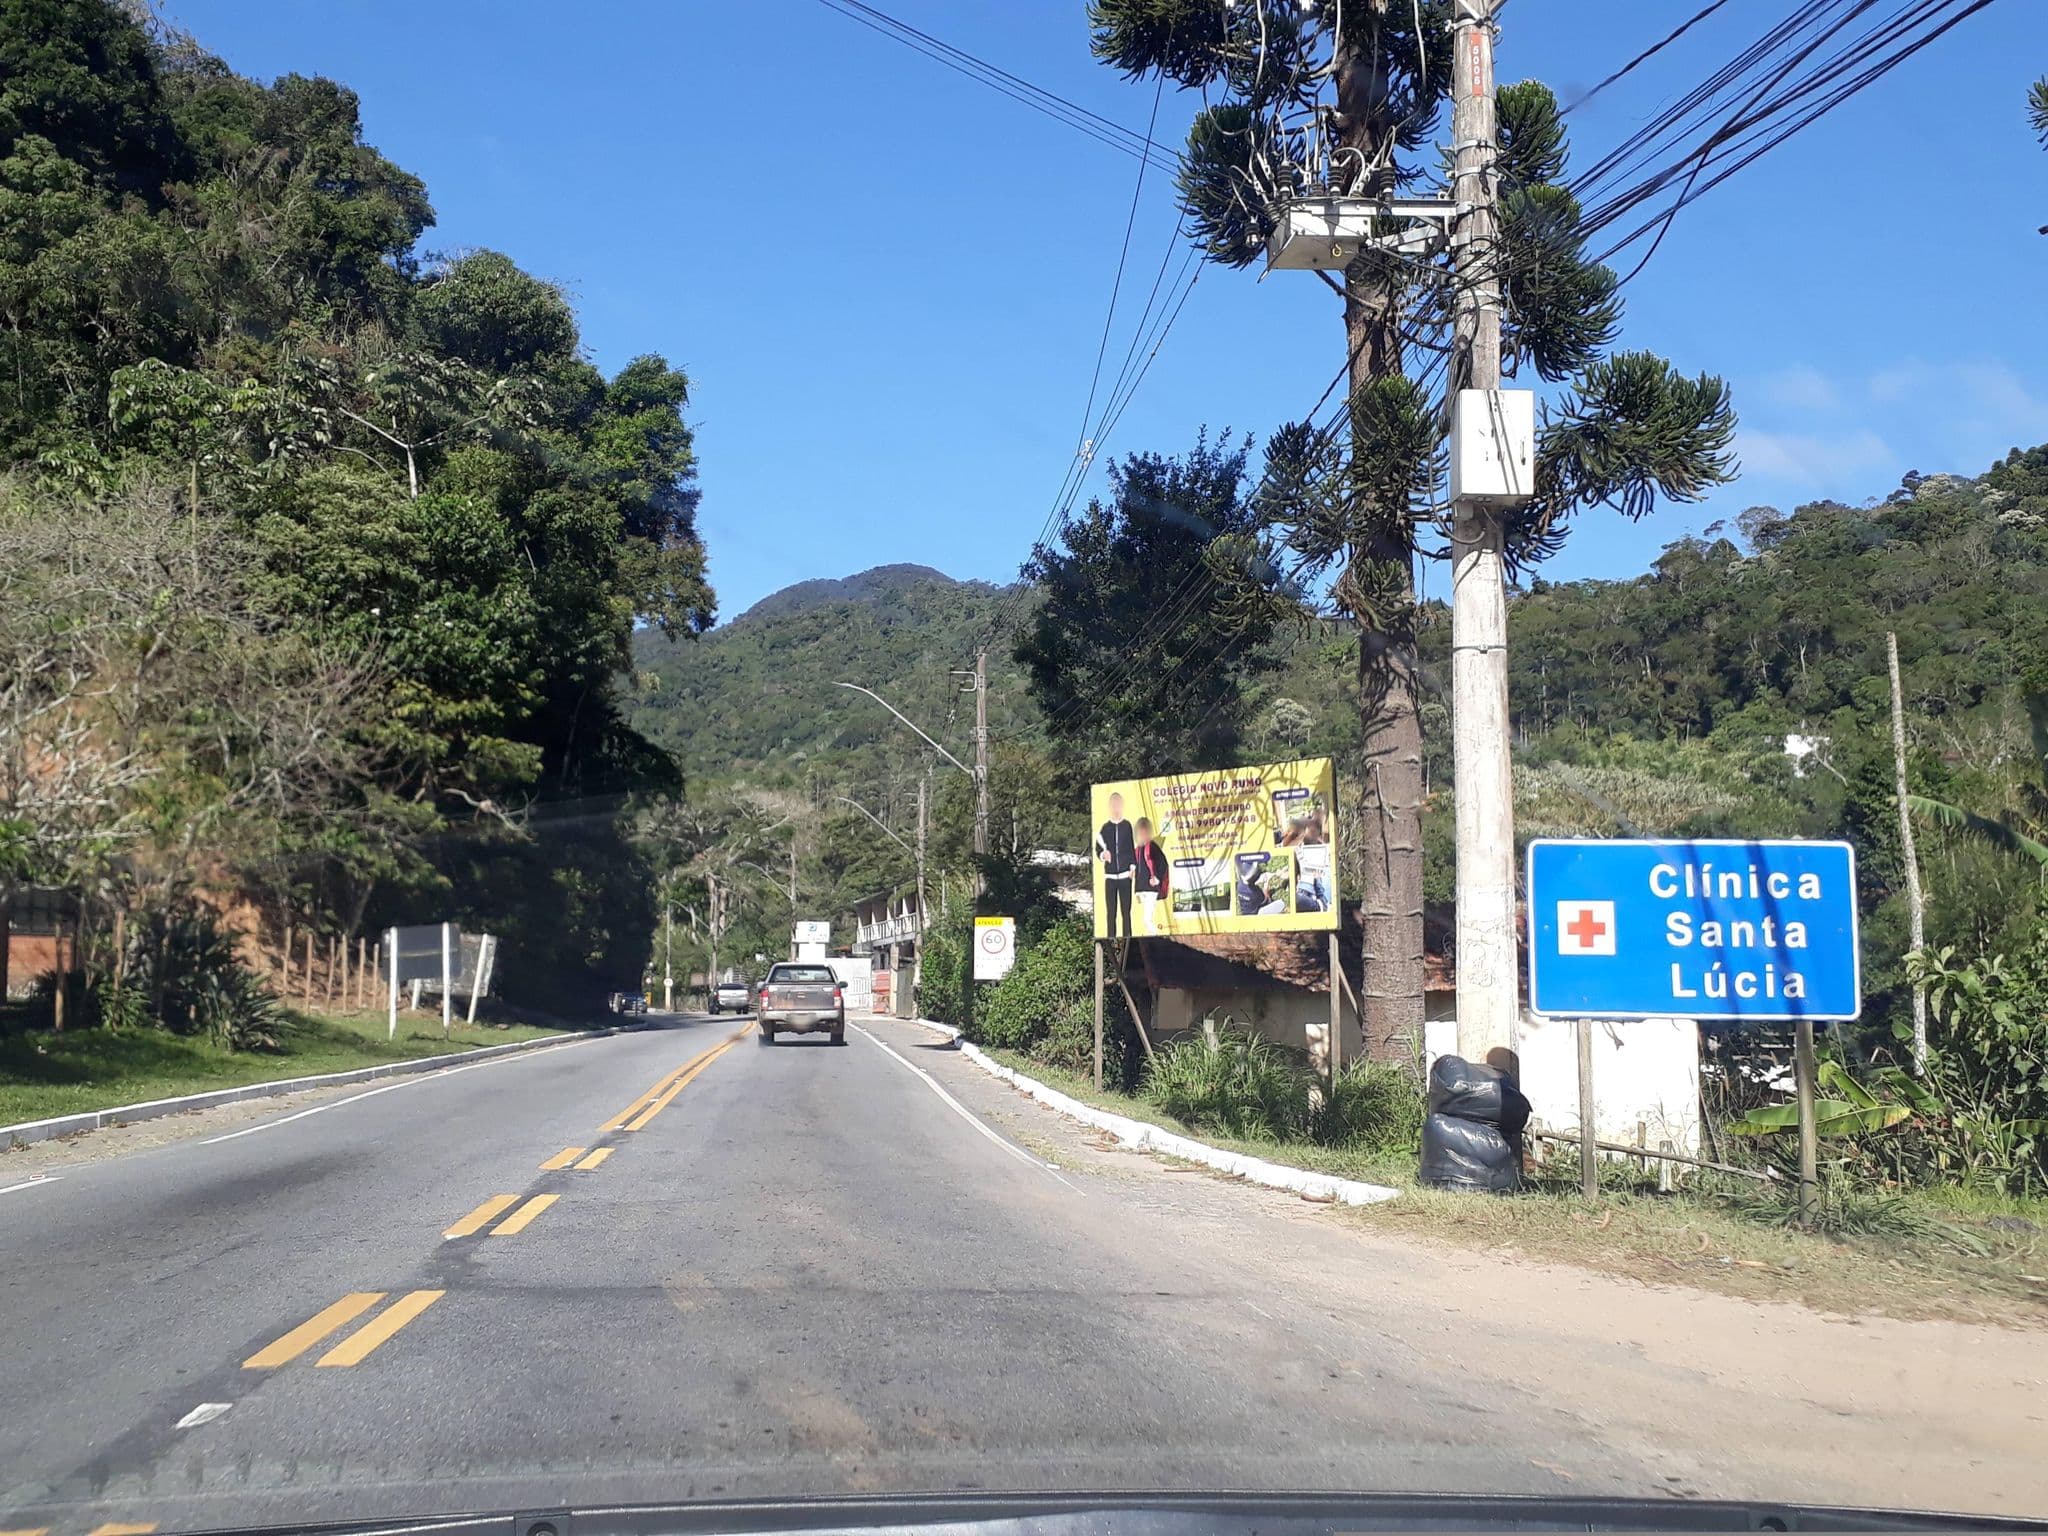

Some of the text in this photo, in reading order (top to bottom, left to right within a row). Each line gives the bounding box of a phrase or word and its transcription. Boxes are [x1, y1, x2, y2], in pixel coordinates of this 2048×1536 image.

[1200, 780, 1228, 793] NOVO
[1231, 777, 1263, 789] RUMO
[1211, 803, 1251, 814] FAZENDO
[1649, 863, 1822, 900] Clínica
[986, 934, 1002, 944] 60
[1666, 911, 1807, 948] Santa
[1671, 962, 1807, 999] Lúcia
